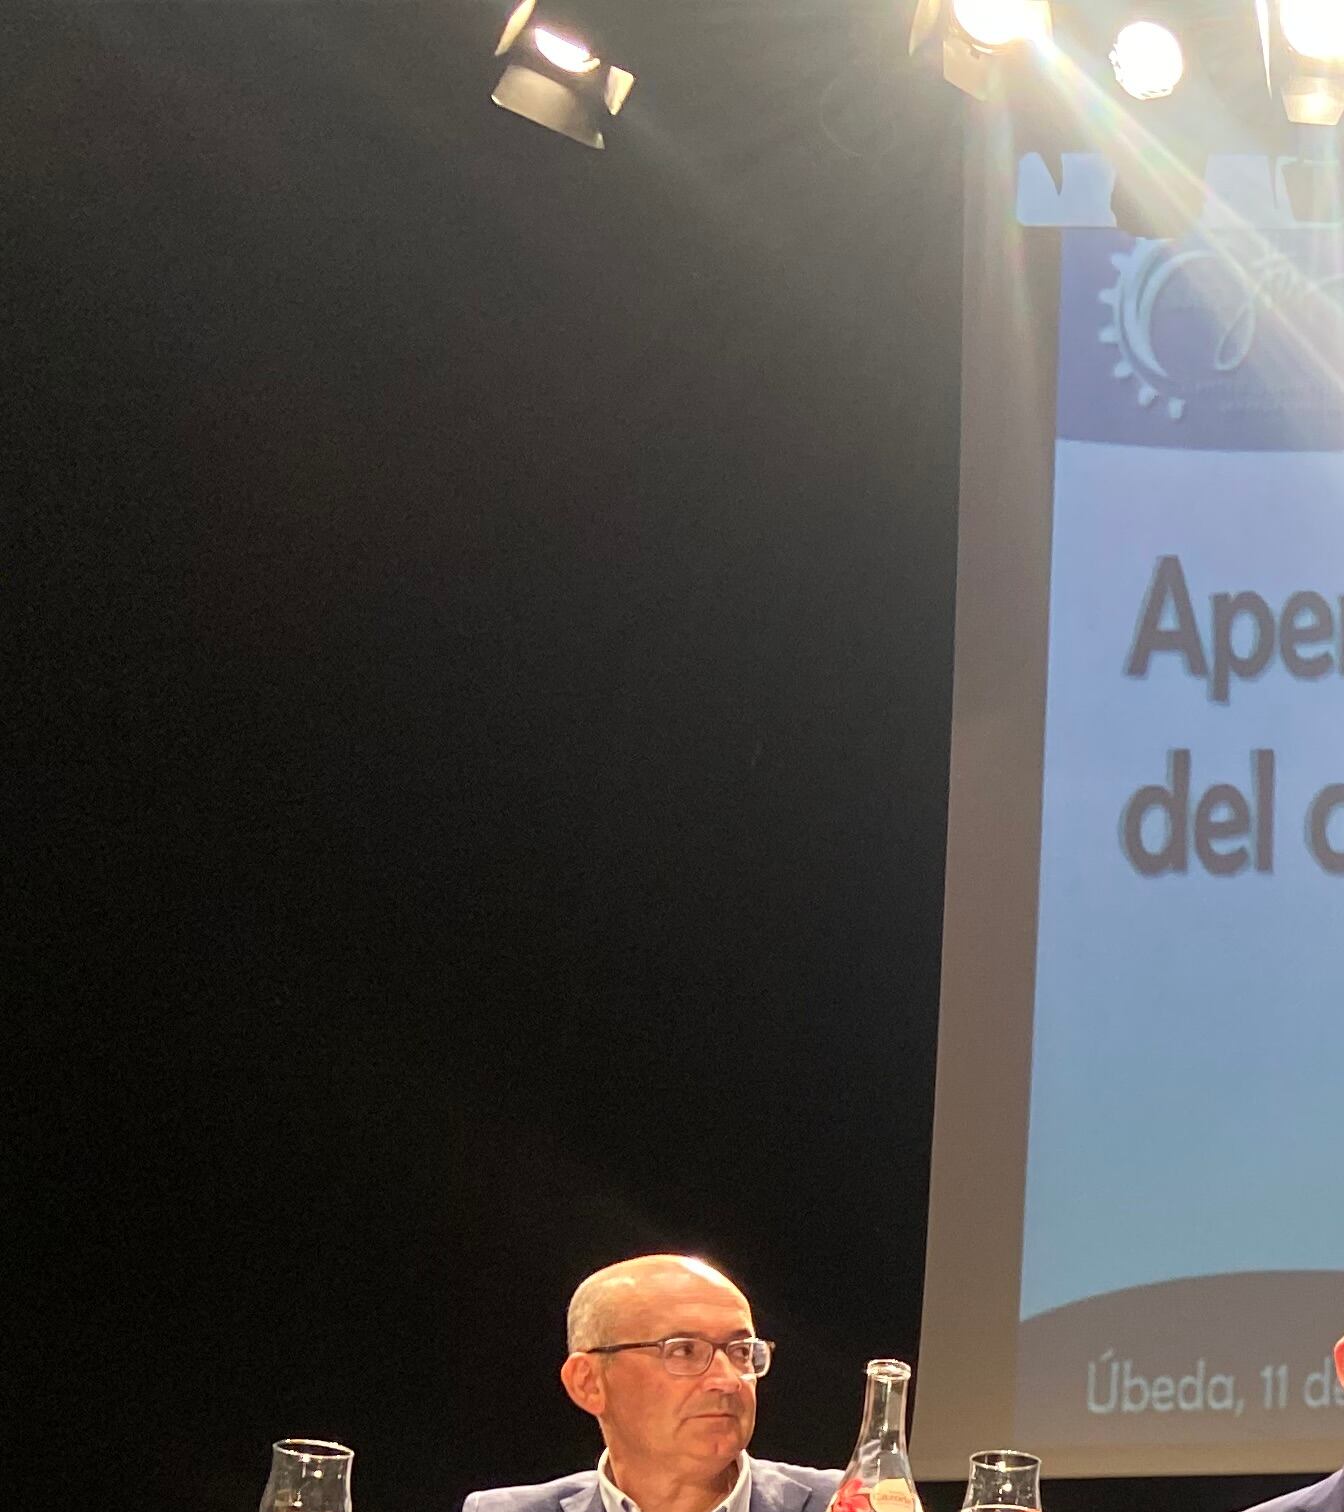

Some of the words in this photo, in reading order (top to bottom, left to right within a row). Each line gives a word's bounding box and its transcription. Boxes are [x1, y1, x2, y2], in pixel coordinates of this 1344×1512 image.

[1119, 748, 1276, 877] del
[1086, 1347, 1246, 1418] Úbeda,
[1260, 1365, 1289, 1409] 11
